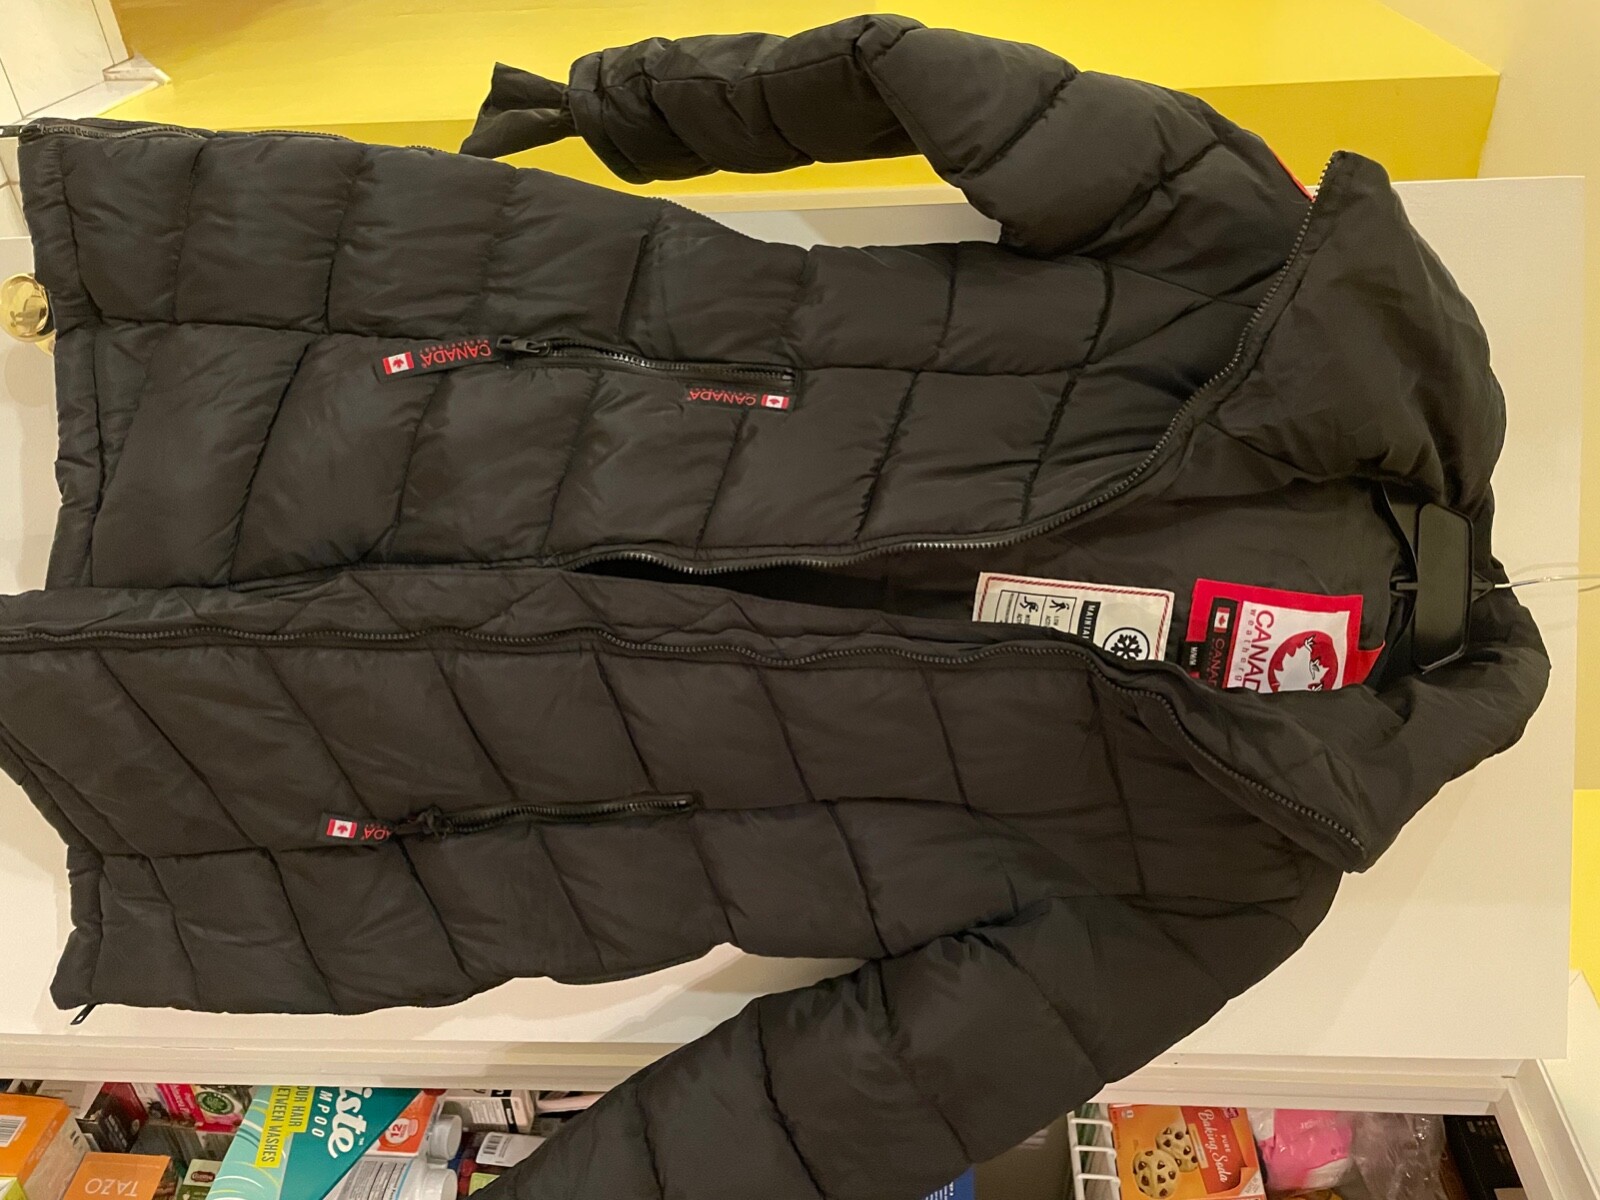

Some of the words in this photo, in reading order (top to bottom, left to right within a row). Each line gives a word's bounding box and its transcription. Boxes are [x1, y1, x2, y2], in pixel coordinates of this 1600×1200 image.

[420, 343, 491, 366] CANADA
[690, 390, 757, 406] CANADA
[288, 1105, 306, 1128] HAIR
[389, 1123, 404, 1139] 12
[261, 1125, 282, 1163] WASHES
[1197, 1109, 1220, 1153] Baking
[1211, 1152, 1232, 1184] Soda
[1220, 1134, 1231, 1153] PURE
[84, 1177, 139, 1197] TAZO
